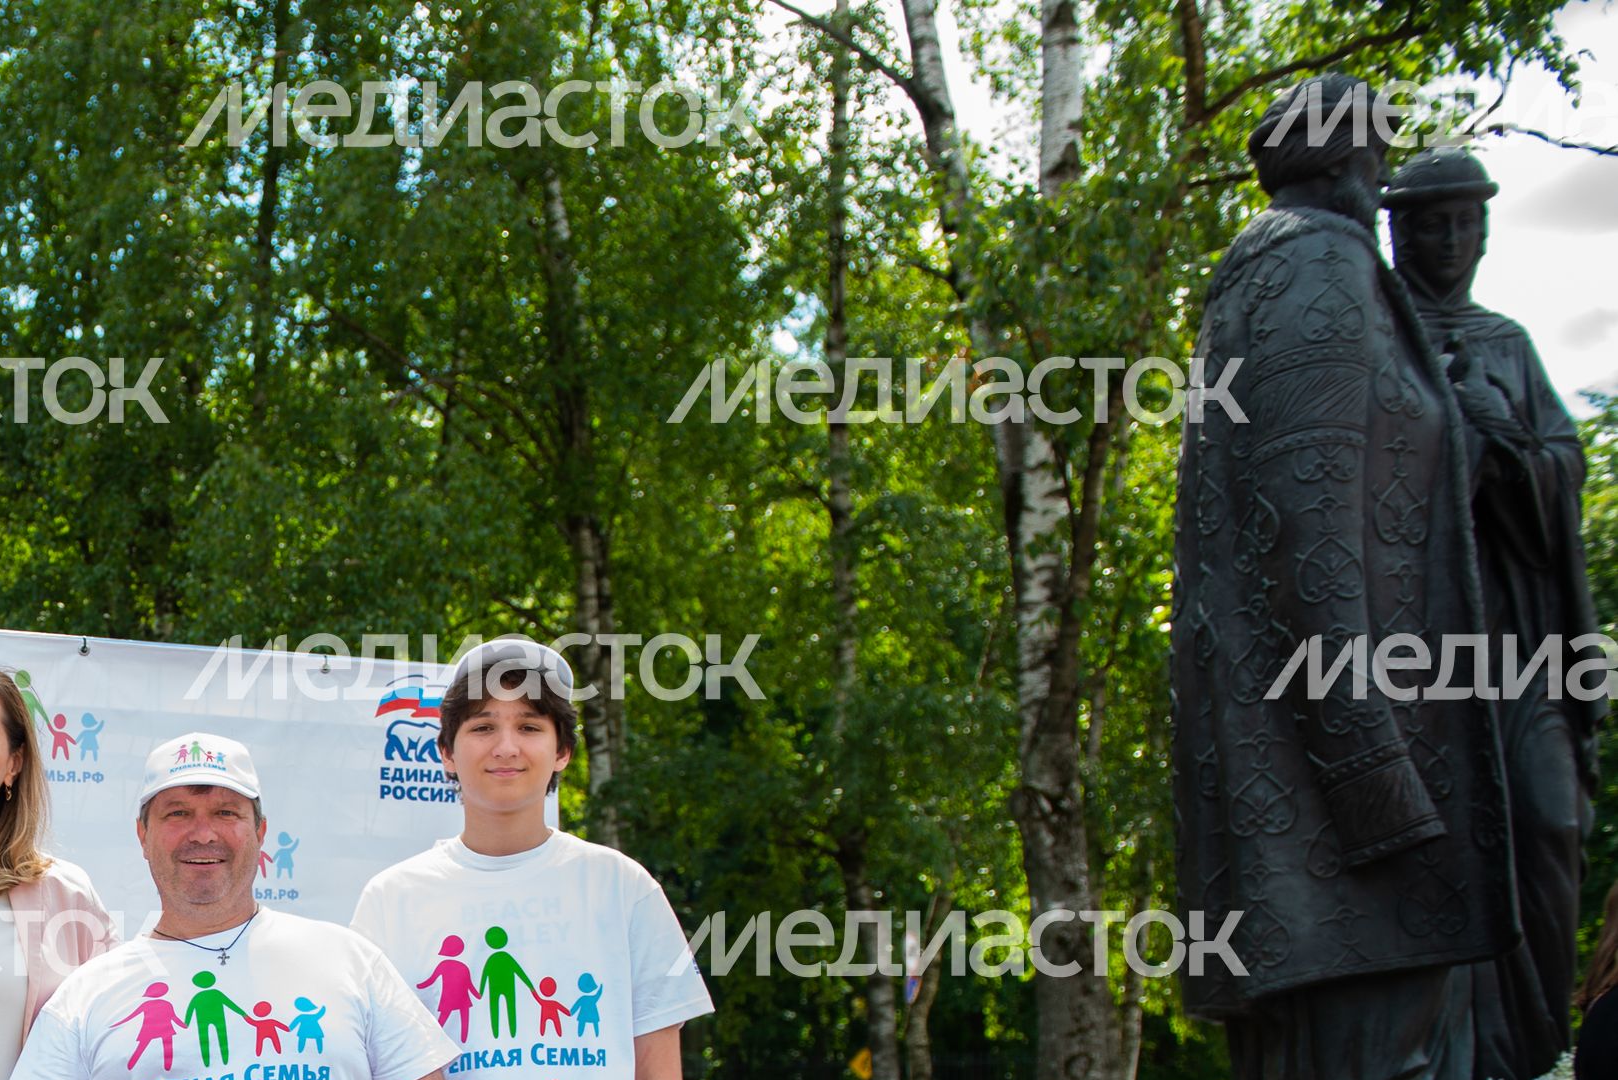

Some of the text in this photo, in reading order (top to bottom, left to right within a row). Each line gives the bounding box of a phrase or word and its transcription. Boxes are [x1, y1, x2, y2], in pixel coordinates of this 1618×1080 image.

[380, 767, 455, 785] ЕДИНА
[380, 784, 456, 803] РОССИЯ
[531, 1043, 606, 1068] СЕМЬЯ
